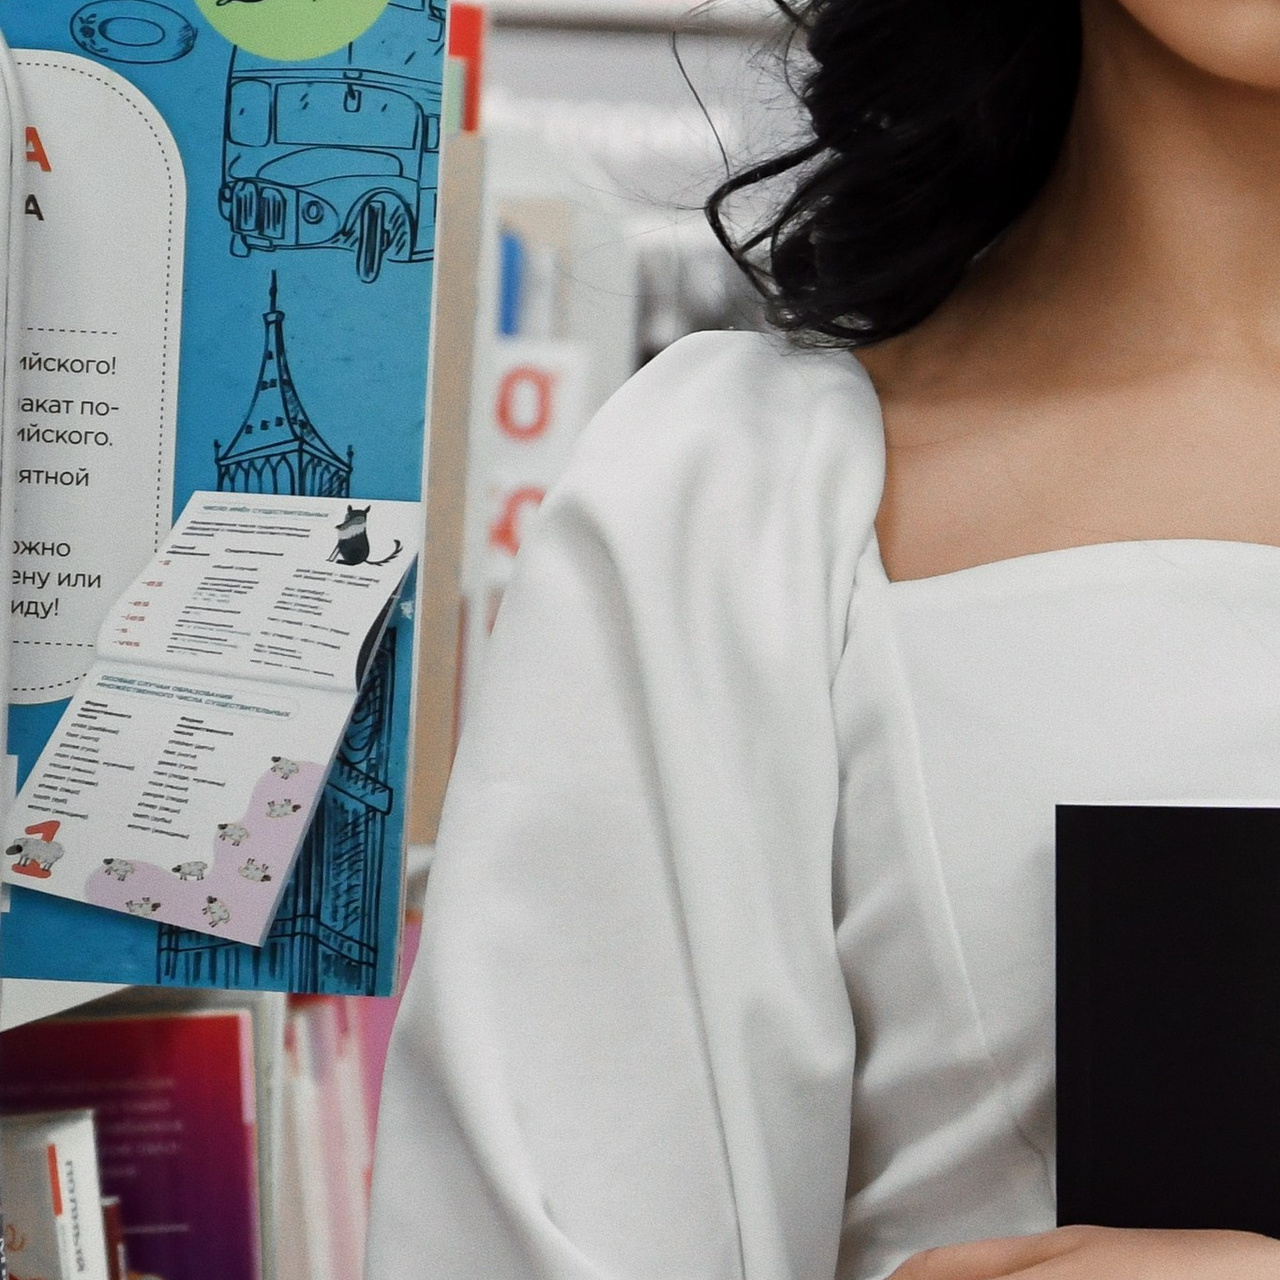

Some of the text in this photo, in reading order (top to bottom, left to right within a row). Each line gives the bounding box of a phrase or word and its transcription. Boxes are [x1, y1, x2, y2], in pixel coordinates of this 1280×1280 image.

[18, 397, 119, 416] акат по-
[57, 572, 101, 589] или
[11, 597, 59, 620] иду!
